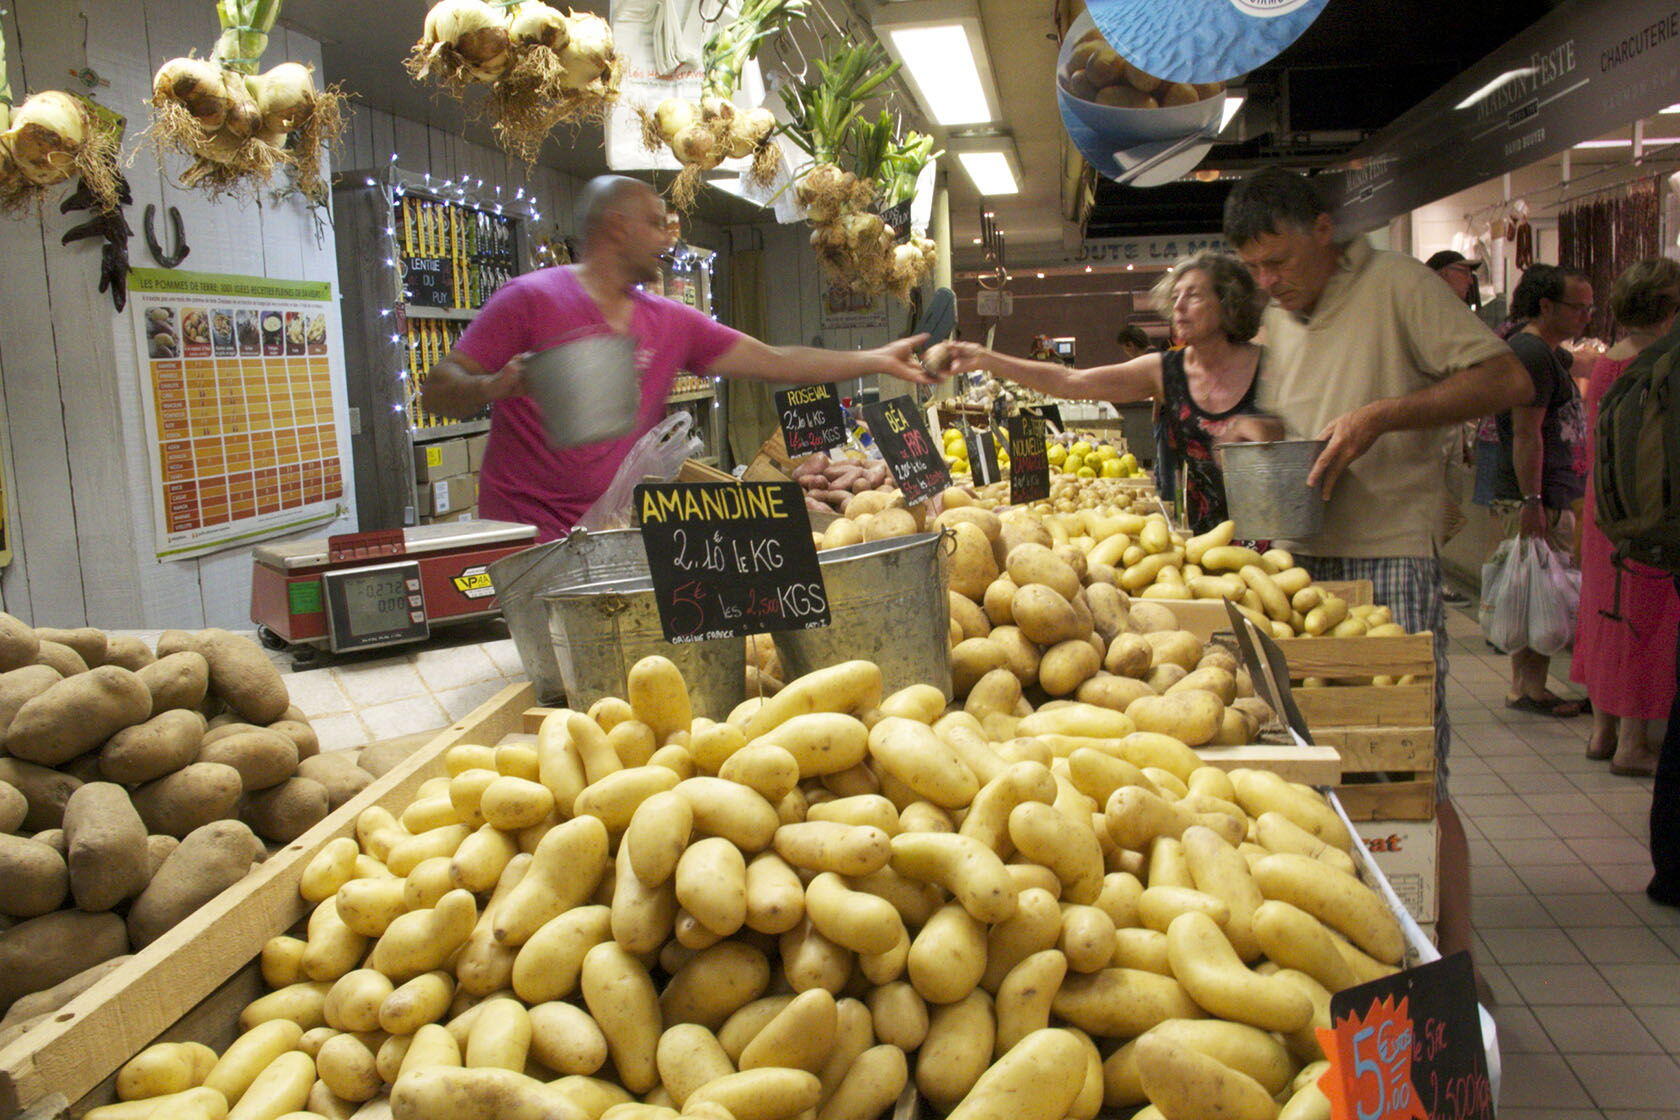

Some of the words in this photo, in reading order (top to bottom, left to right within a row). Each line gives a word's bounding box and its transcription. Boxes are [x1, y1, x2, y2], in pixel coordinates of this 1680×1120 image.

[1600, 12, 1679, 72] CHARCUTERIE
[432, 290, 447, 304] PUY
[787, 384, 831, 406] ROSEVAL
[821, 426, 841, 443] KGS
[642, 486, 788, 524] AMANDINE
[749, 538, 784, 572] KG
[776, 583, 826, 619] KGS
[706, 630, 735, 641] FRANCE
